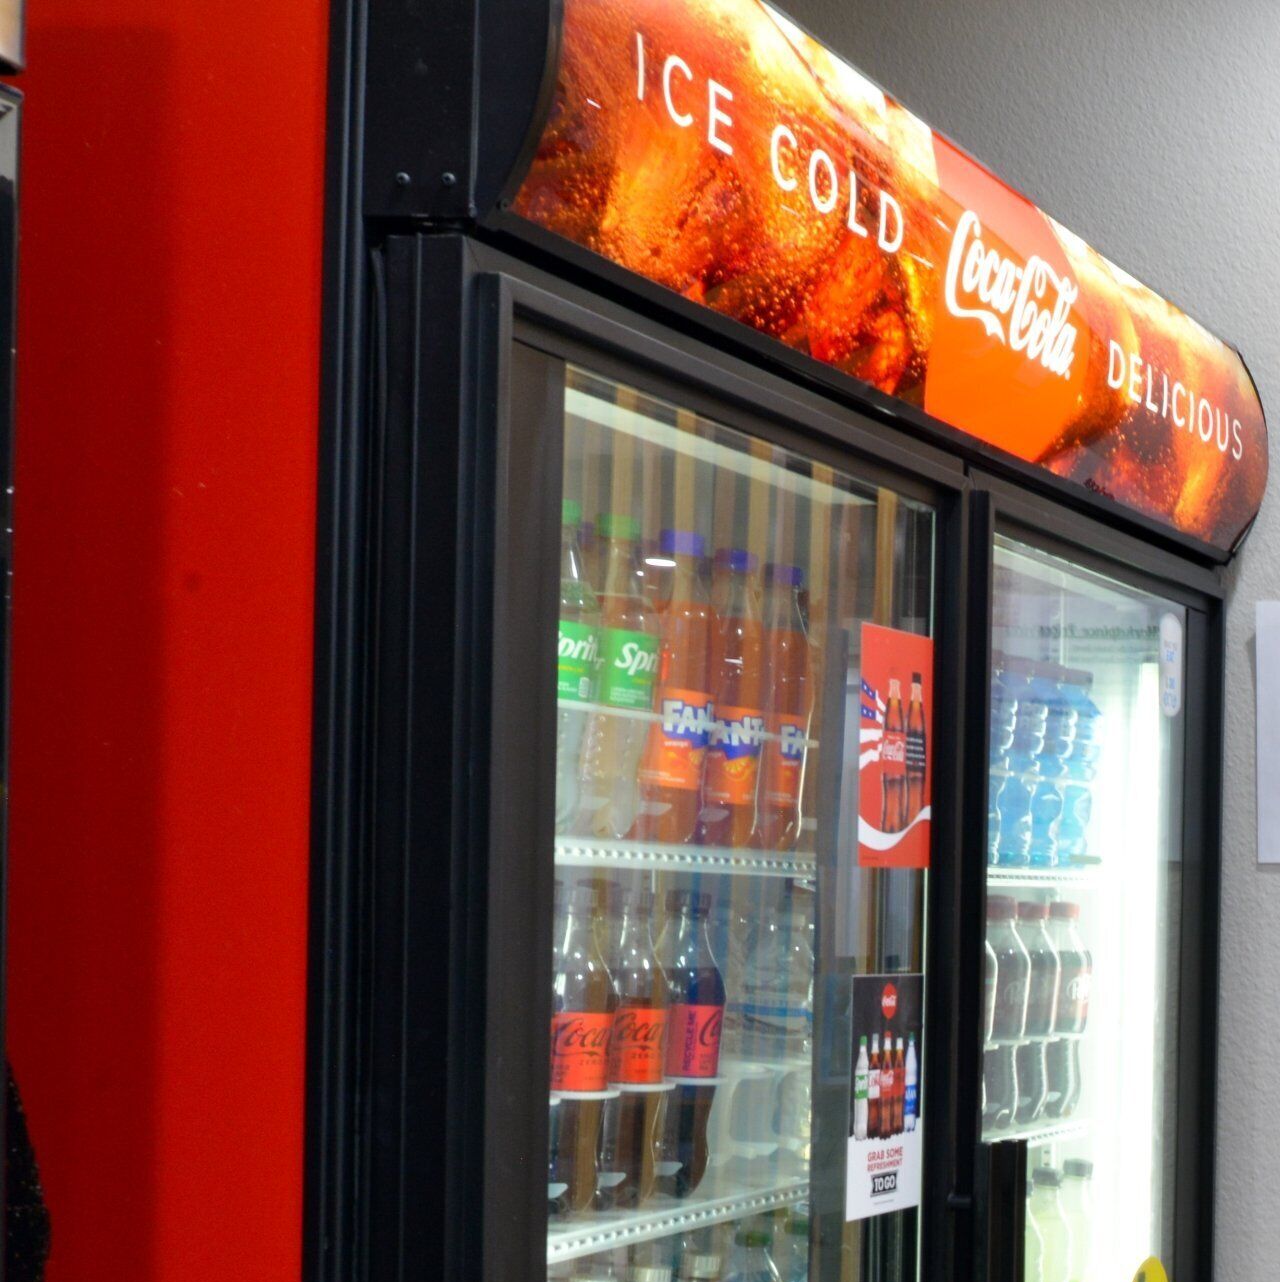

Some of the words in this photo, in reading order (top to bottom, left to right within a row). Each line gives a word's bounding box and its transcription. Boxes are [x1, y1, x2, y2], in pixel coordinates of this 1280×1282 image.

[635, 32, 734, 156] ICE
[769, 124, 905, 254] COLD
[944, 210, 1080, 381] Coca-Cola
[1107, 340, 1244, 461] DELICIOUS
[613, 642, 659, 677] Spri
[662, 700, 712, 733] FAN
[711, 715, 764, 746] ANT
[866, 1149, 885, 1163] GRAB
[885, 1145, 904, 1159] SOME
[866, 1157, 904, 1173] REFRESHMENT
